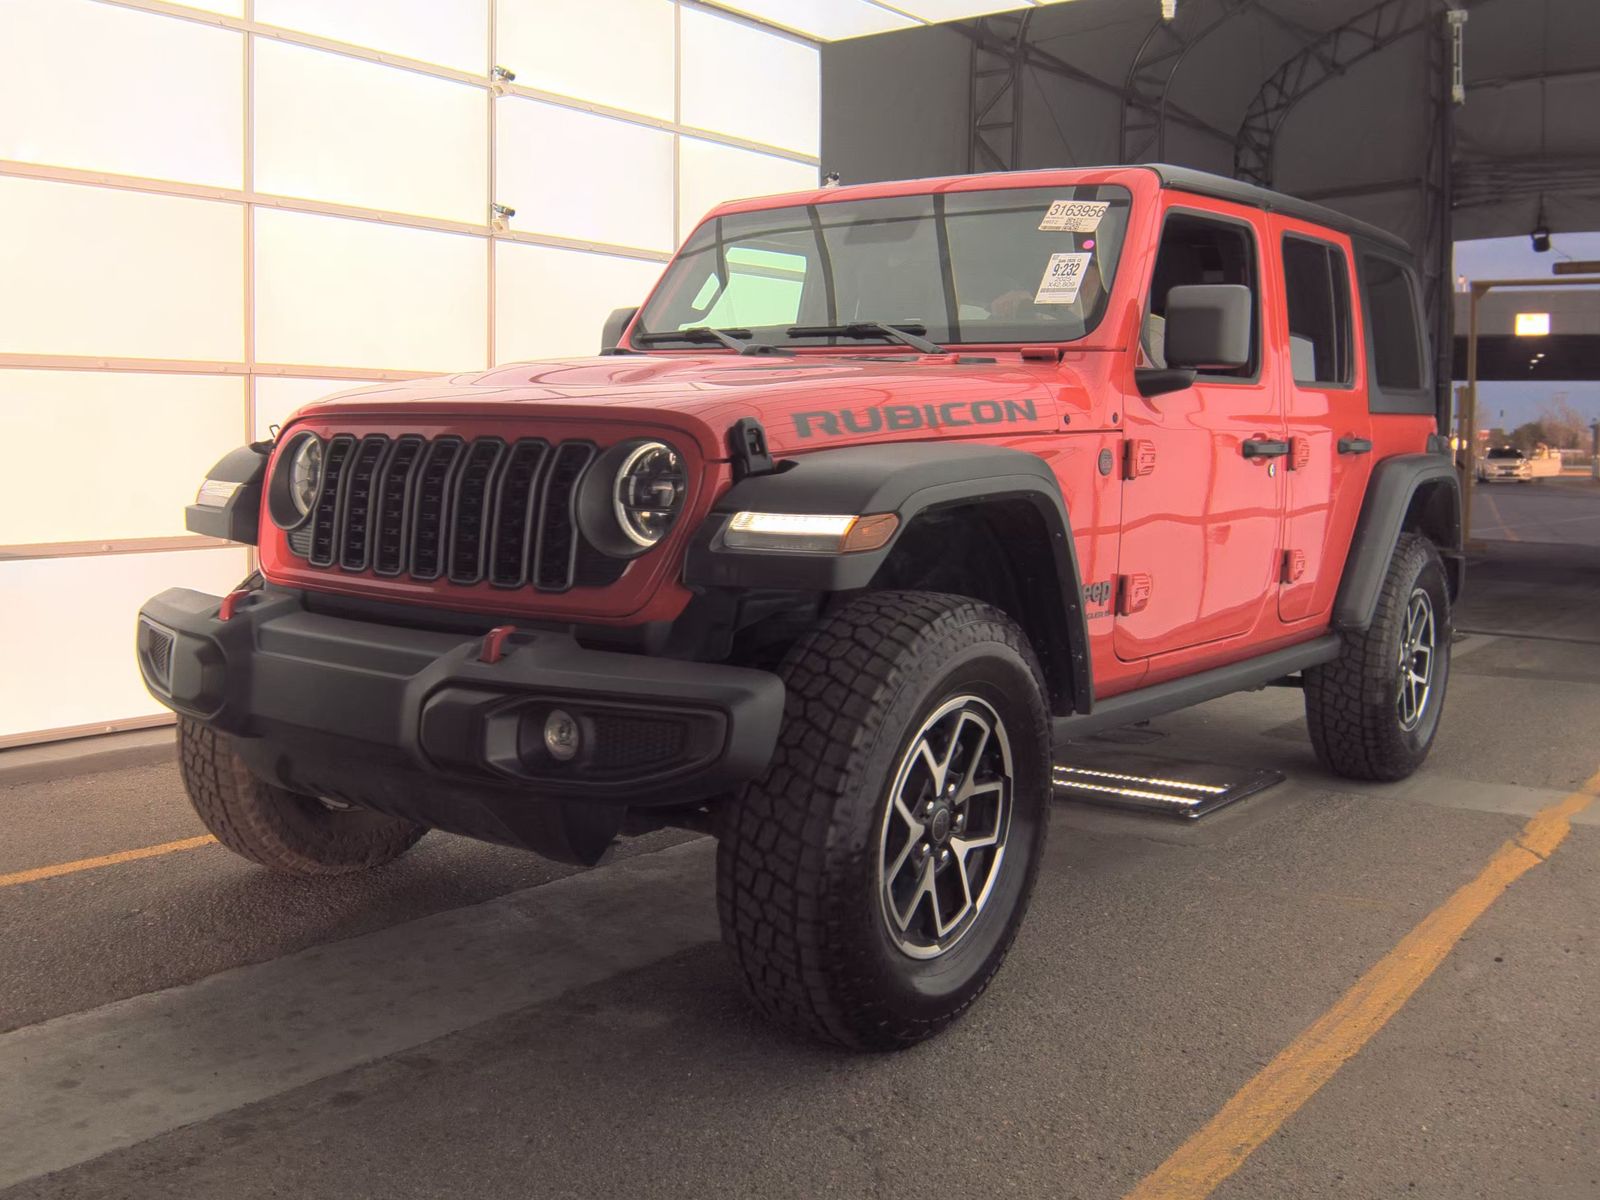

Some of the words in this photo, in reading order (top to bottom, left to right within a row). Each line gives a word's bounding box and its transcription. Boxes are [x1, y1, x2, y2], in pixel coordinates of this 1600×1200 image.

[1050, 204, 1107, 218] 3163956
[1052, 263, 1081, 277] 9:232
[790, 399, 1038, 438] RUBICON
[1082, 581, 1112, 606] eep
